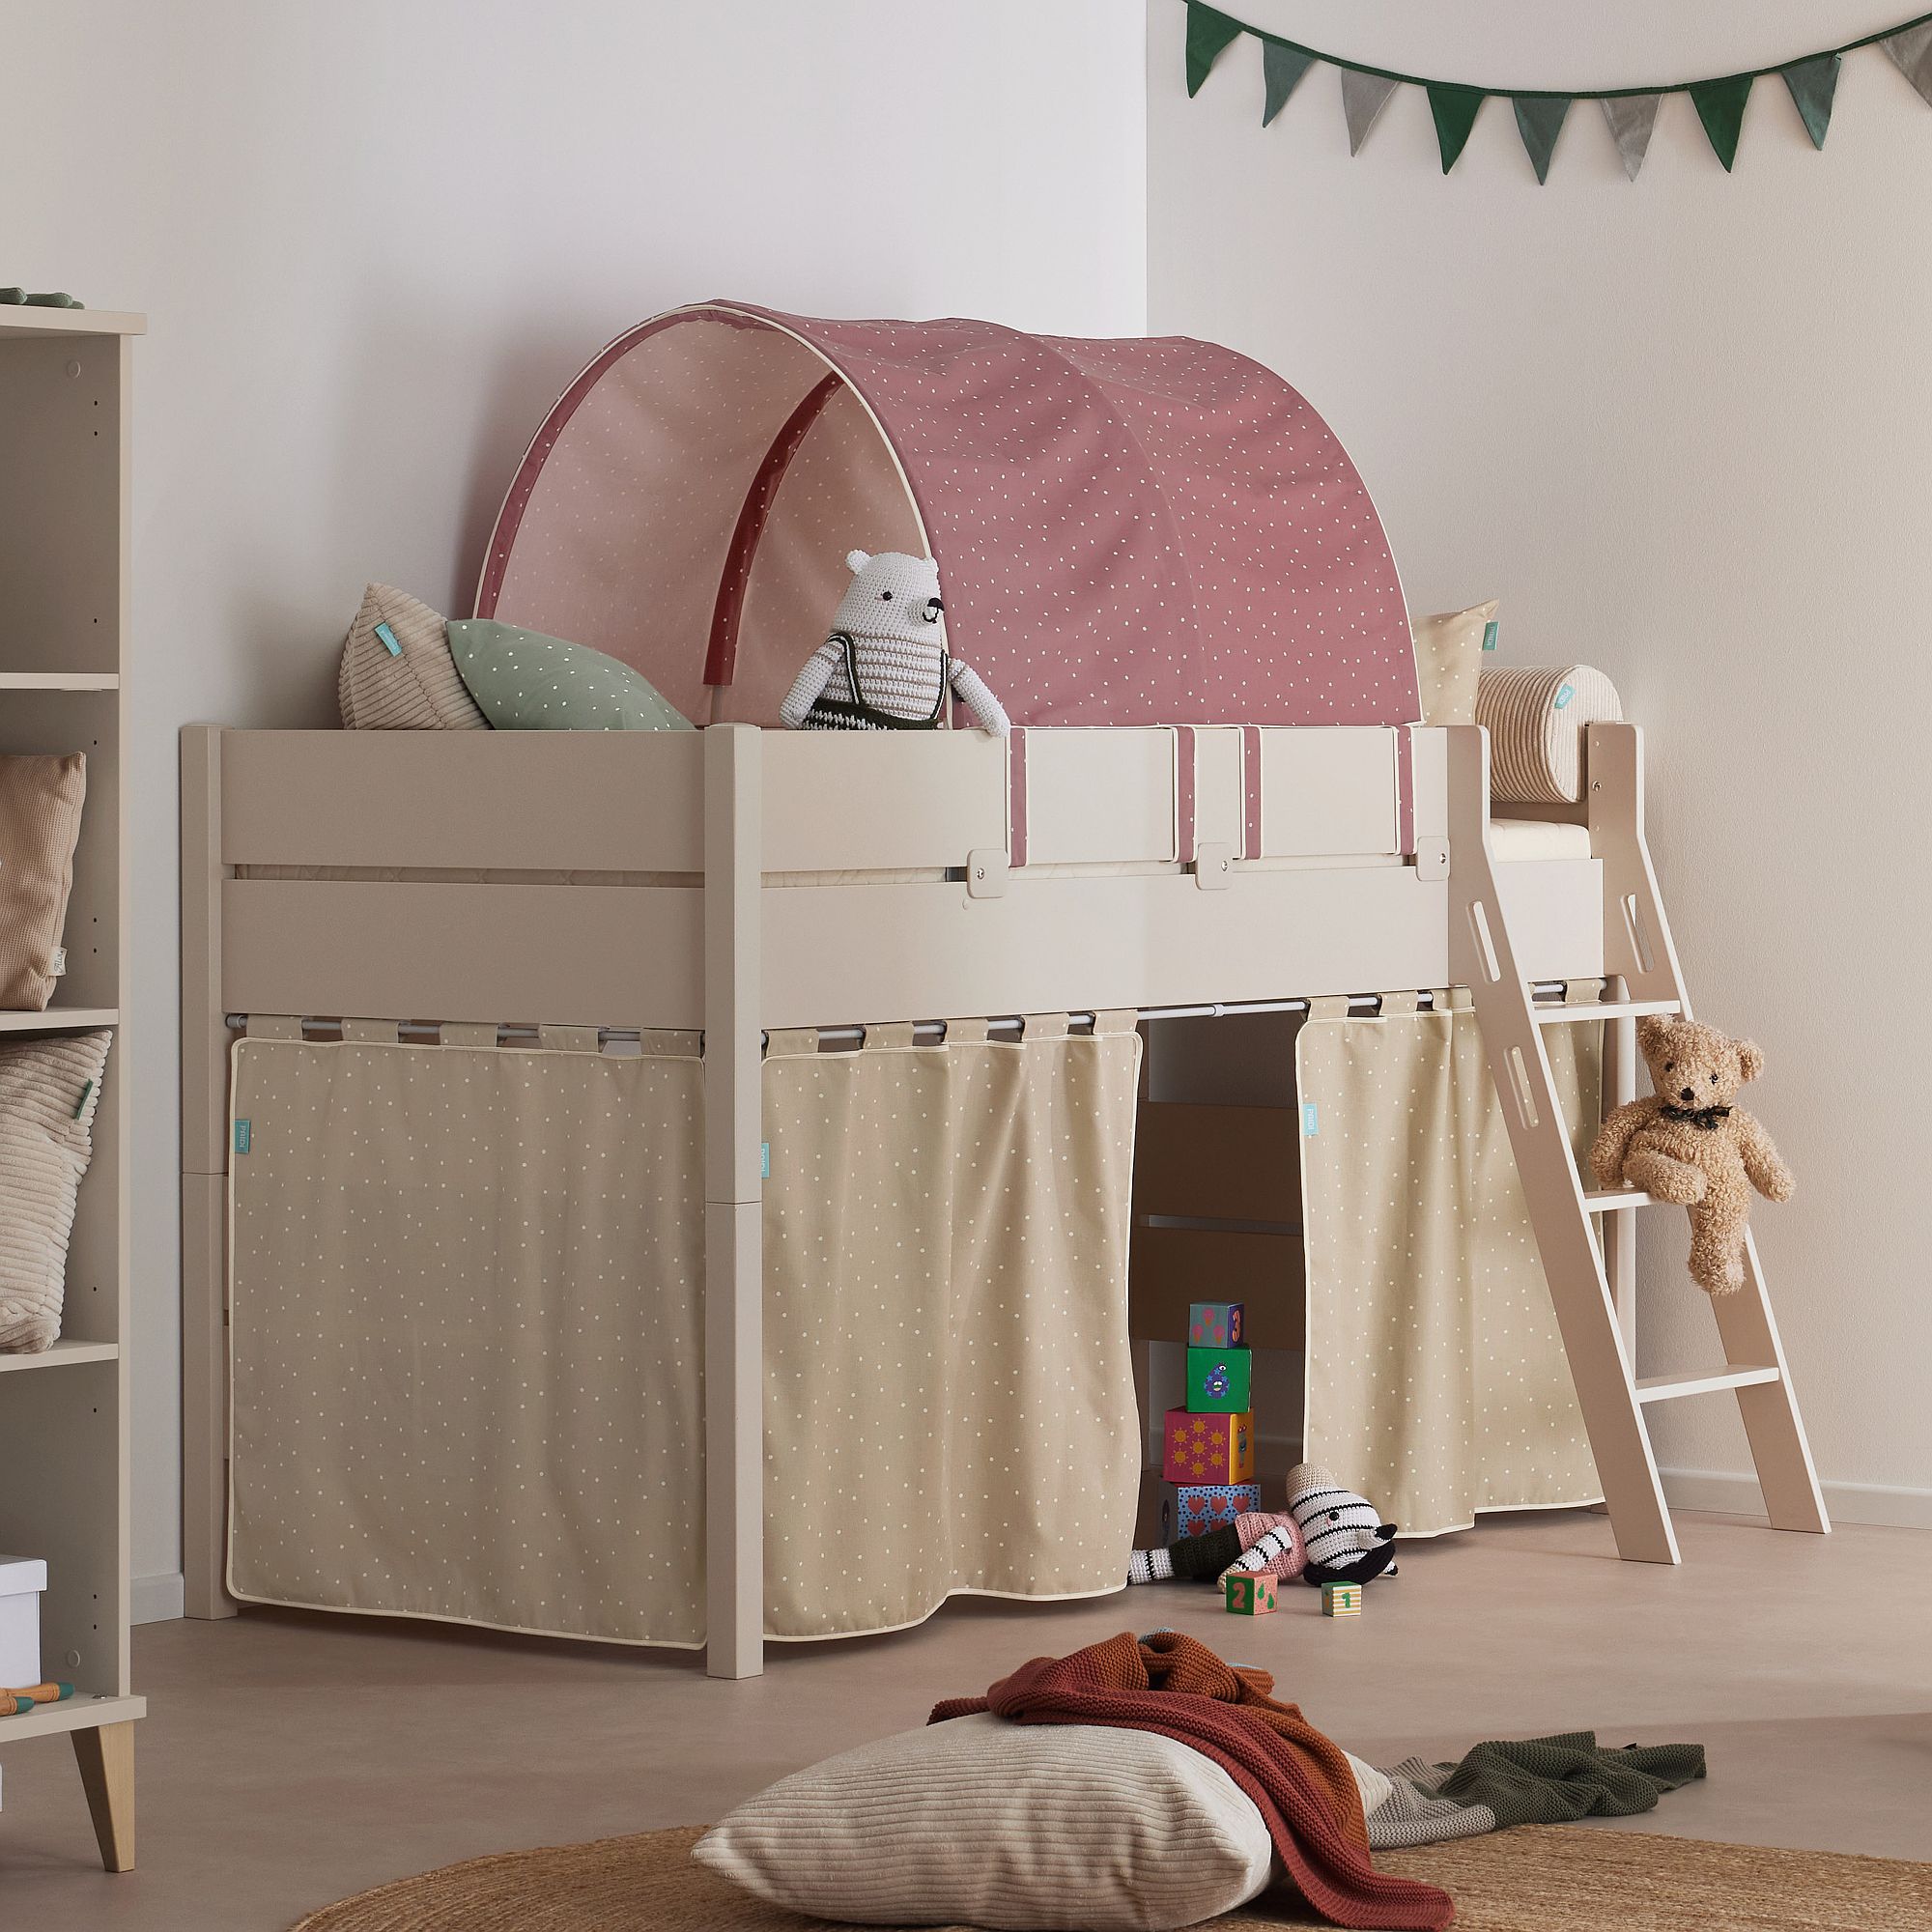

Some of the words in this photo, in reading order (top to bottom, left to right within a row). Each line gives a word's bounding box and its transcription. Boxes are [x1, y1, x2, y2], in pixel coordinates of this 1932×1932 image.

[1232, 1310, 1241, 1342] 3
[1204, 1362, 1231, 1400] 6
[1232, 1581, 1246, 1608] 2
[1342, 1592, 1351, 1608] 1
